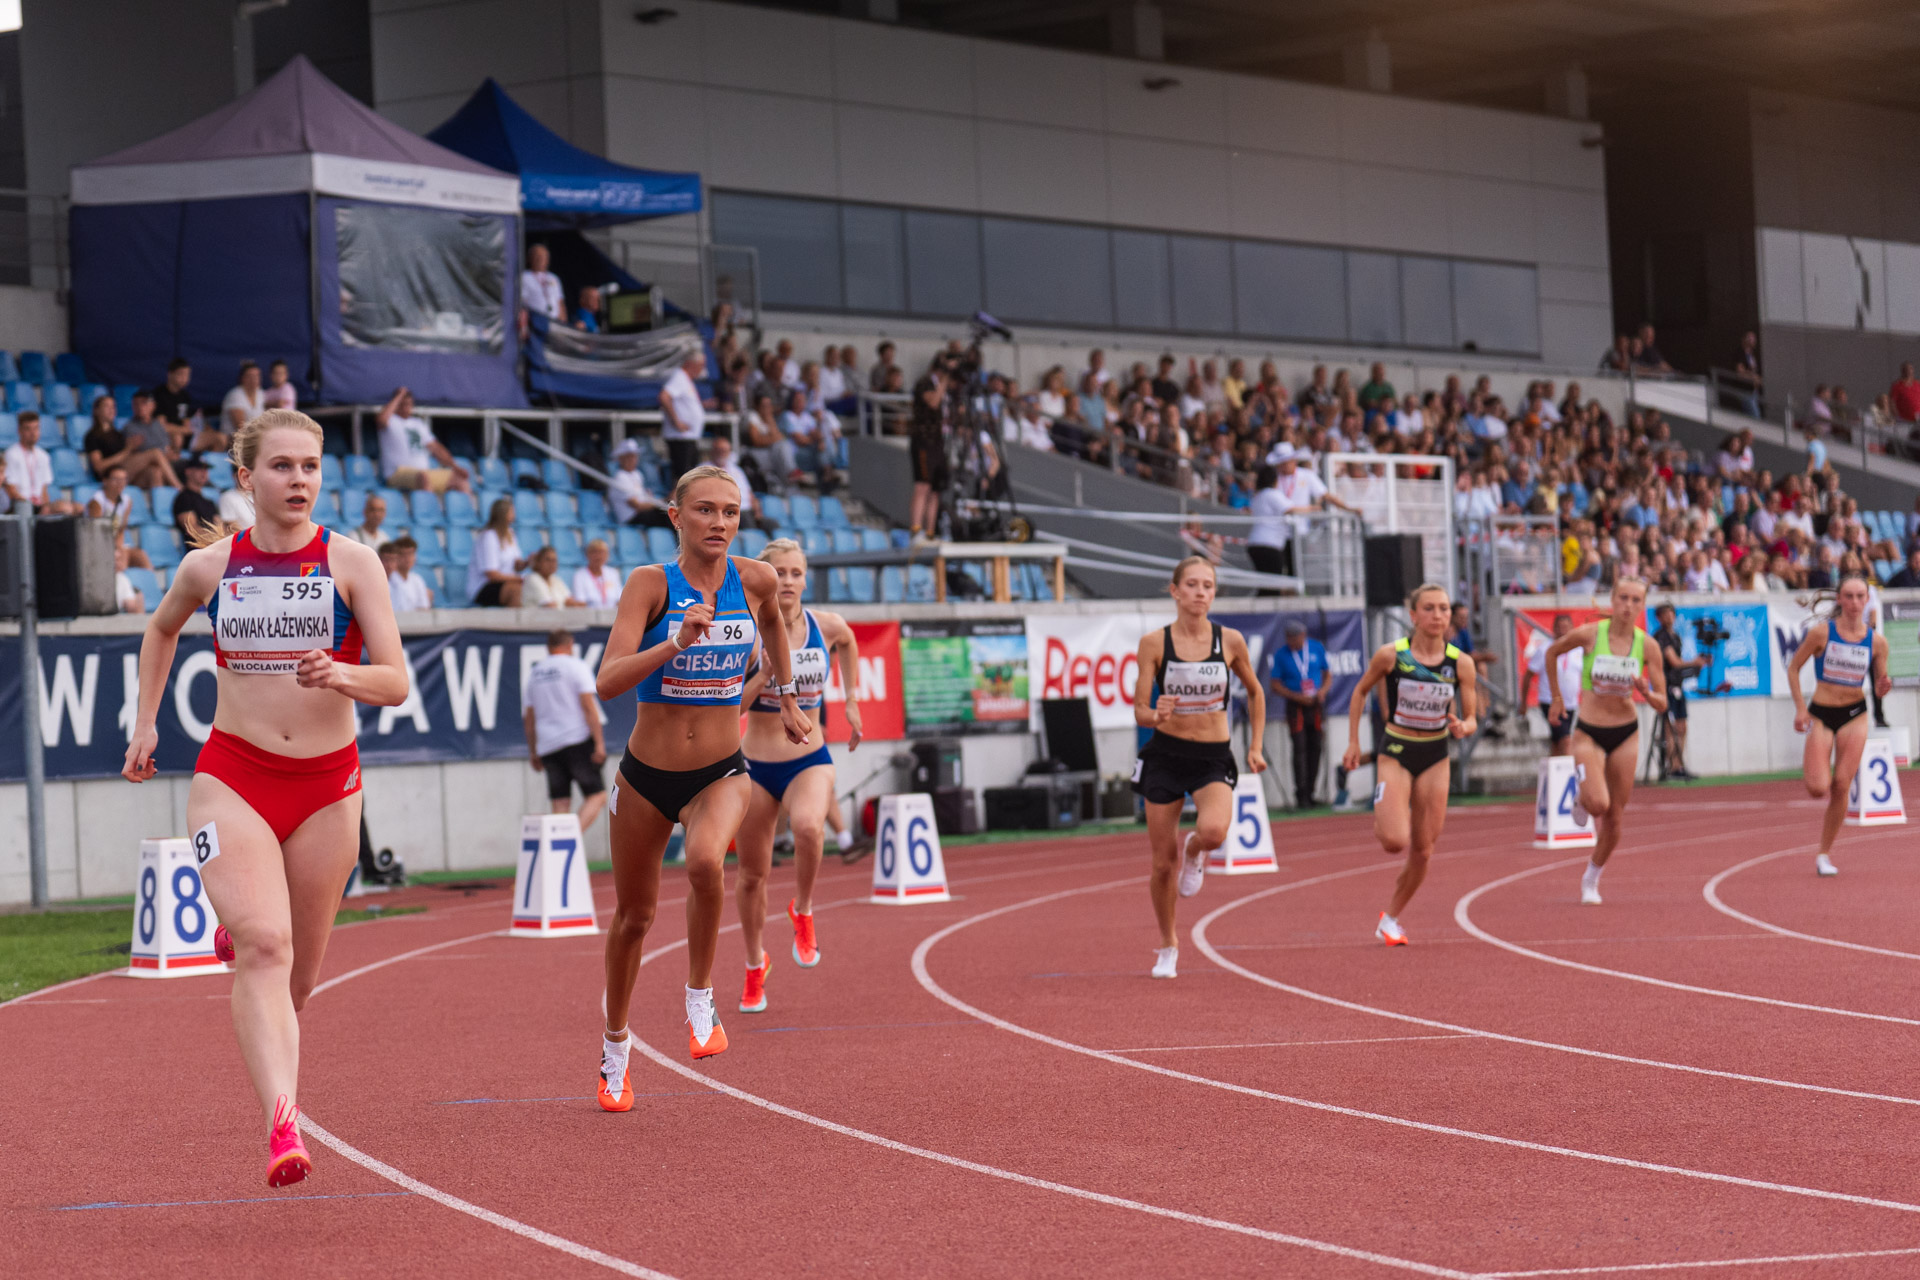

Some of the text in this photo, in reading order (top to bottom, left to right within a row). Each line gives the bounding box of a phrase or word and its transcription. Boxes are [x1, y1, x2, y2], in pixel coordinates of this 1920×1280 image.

[282, 582, 322, 600] 595
[221, 611, 329, 638] NOWAK ŁAŻEWSKA
[723, 625, 743, 640] 96
[231, 662, 295, 671] WŁOCŁAWEK
[672, 650, 746, 672] CIEŚLAK
[796, 652, 819, 664] 344
[1198, 665, 1219, 675] 407
[671, 687, 737, 696] WŁOCŁAWEK 2025
[1167, 683, 1222, 696] SADLEJA
[1558, 776, 1577, 815] 4
[1869, 758, 1892, 803] 3
[1238, 795, 1261, 848] 5
[195, 831, 211, 863] 8
[881, 818, 895, 878] 6
[908, 816, 932, 876] 6
[522, 839, 540, 908] 7
[551, 838, 576, 908] 7
[139, 866, 156, 945] 8
[172, 866, 206, 943] 8
